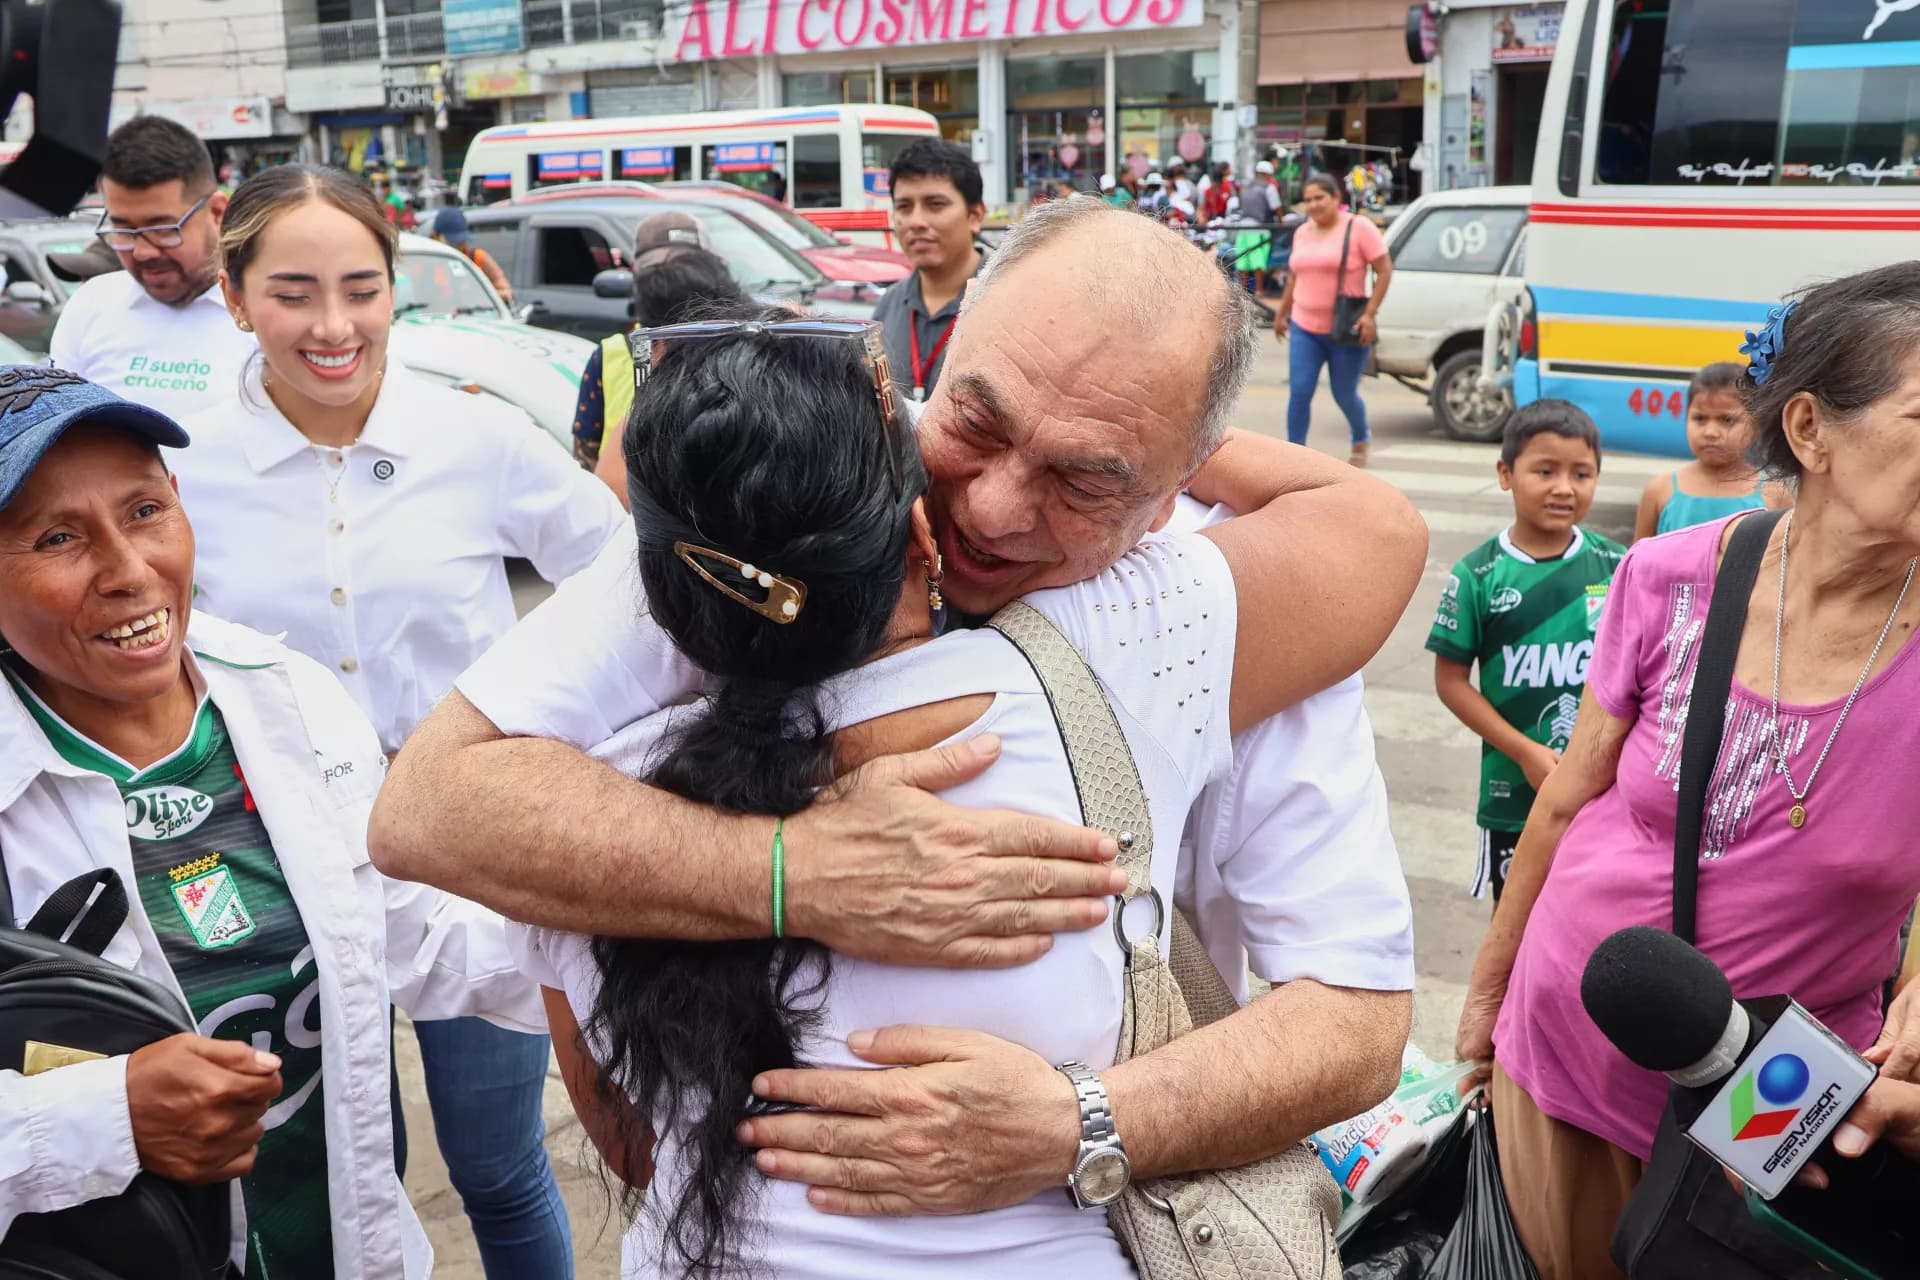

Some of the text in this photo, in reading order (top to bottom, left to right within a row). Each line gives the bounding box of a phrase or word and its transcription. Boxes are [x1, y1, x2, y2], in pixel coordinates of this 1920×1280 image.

[1439, 220, 1487, 260] 09
[129, 355, 211, 376] El sueño
[123, 373, 208, 392] cruceño
[1627, 387, 1684, 418] 404
[124, 792, 209, 828] Olive
[154, 810, 193, 839] Sport
[1780, 1100, 1842, 1169] RED NACIONAL
